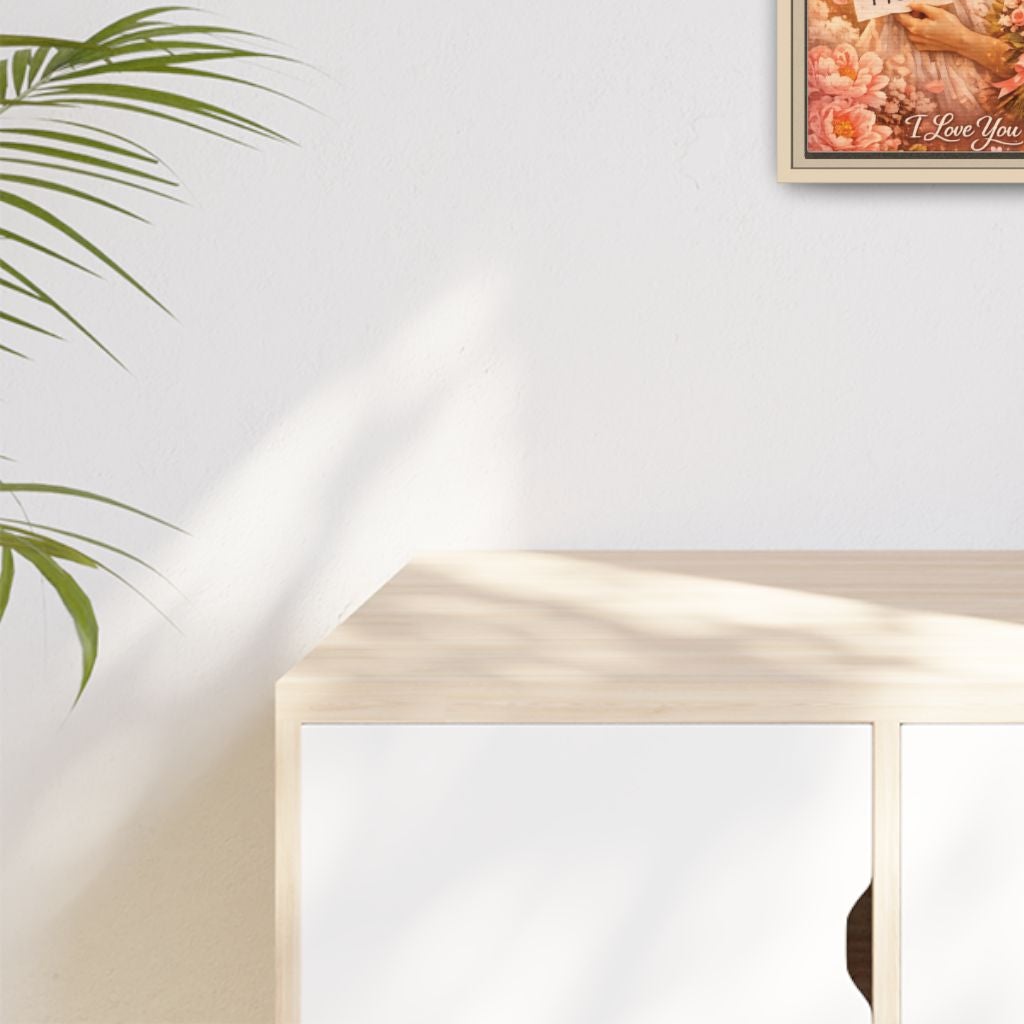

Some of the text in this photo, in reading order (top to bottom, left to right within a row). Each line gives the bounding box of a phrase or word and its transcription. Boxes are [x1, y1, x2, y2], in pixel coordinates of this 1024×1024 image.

[904, 113, 928, 139] I
[923, 112, 975, 143] Love
[970, 115, 1024, 152] You
